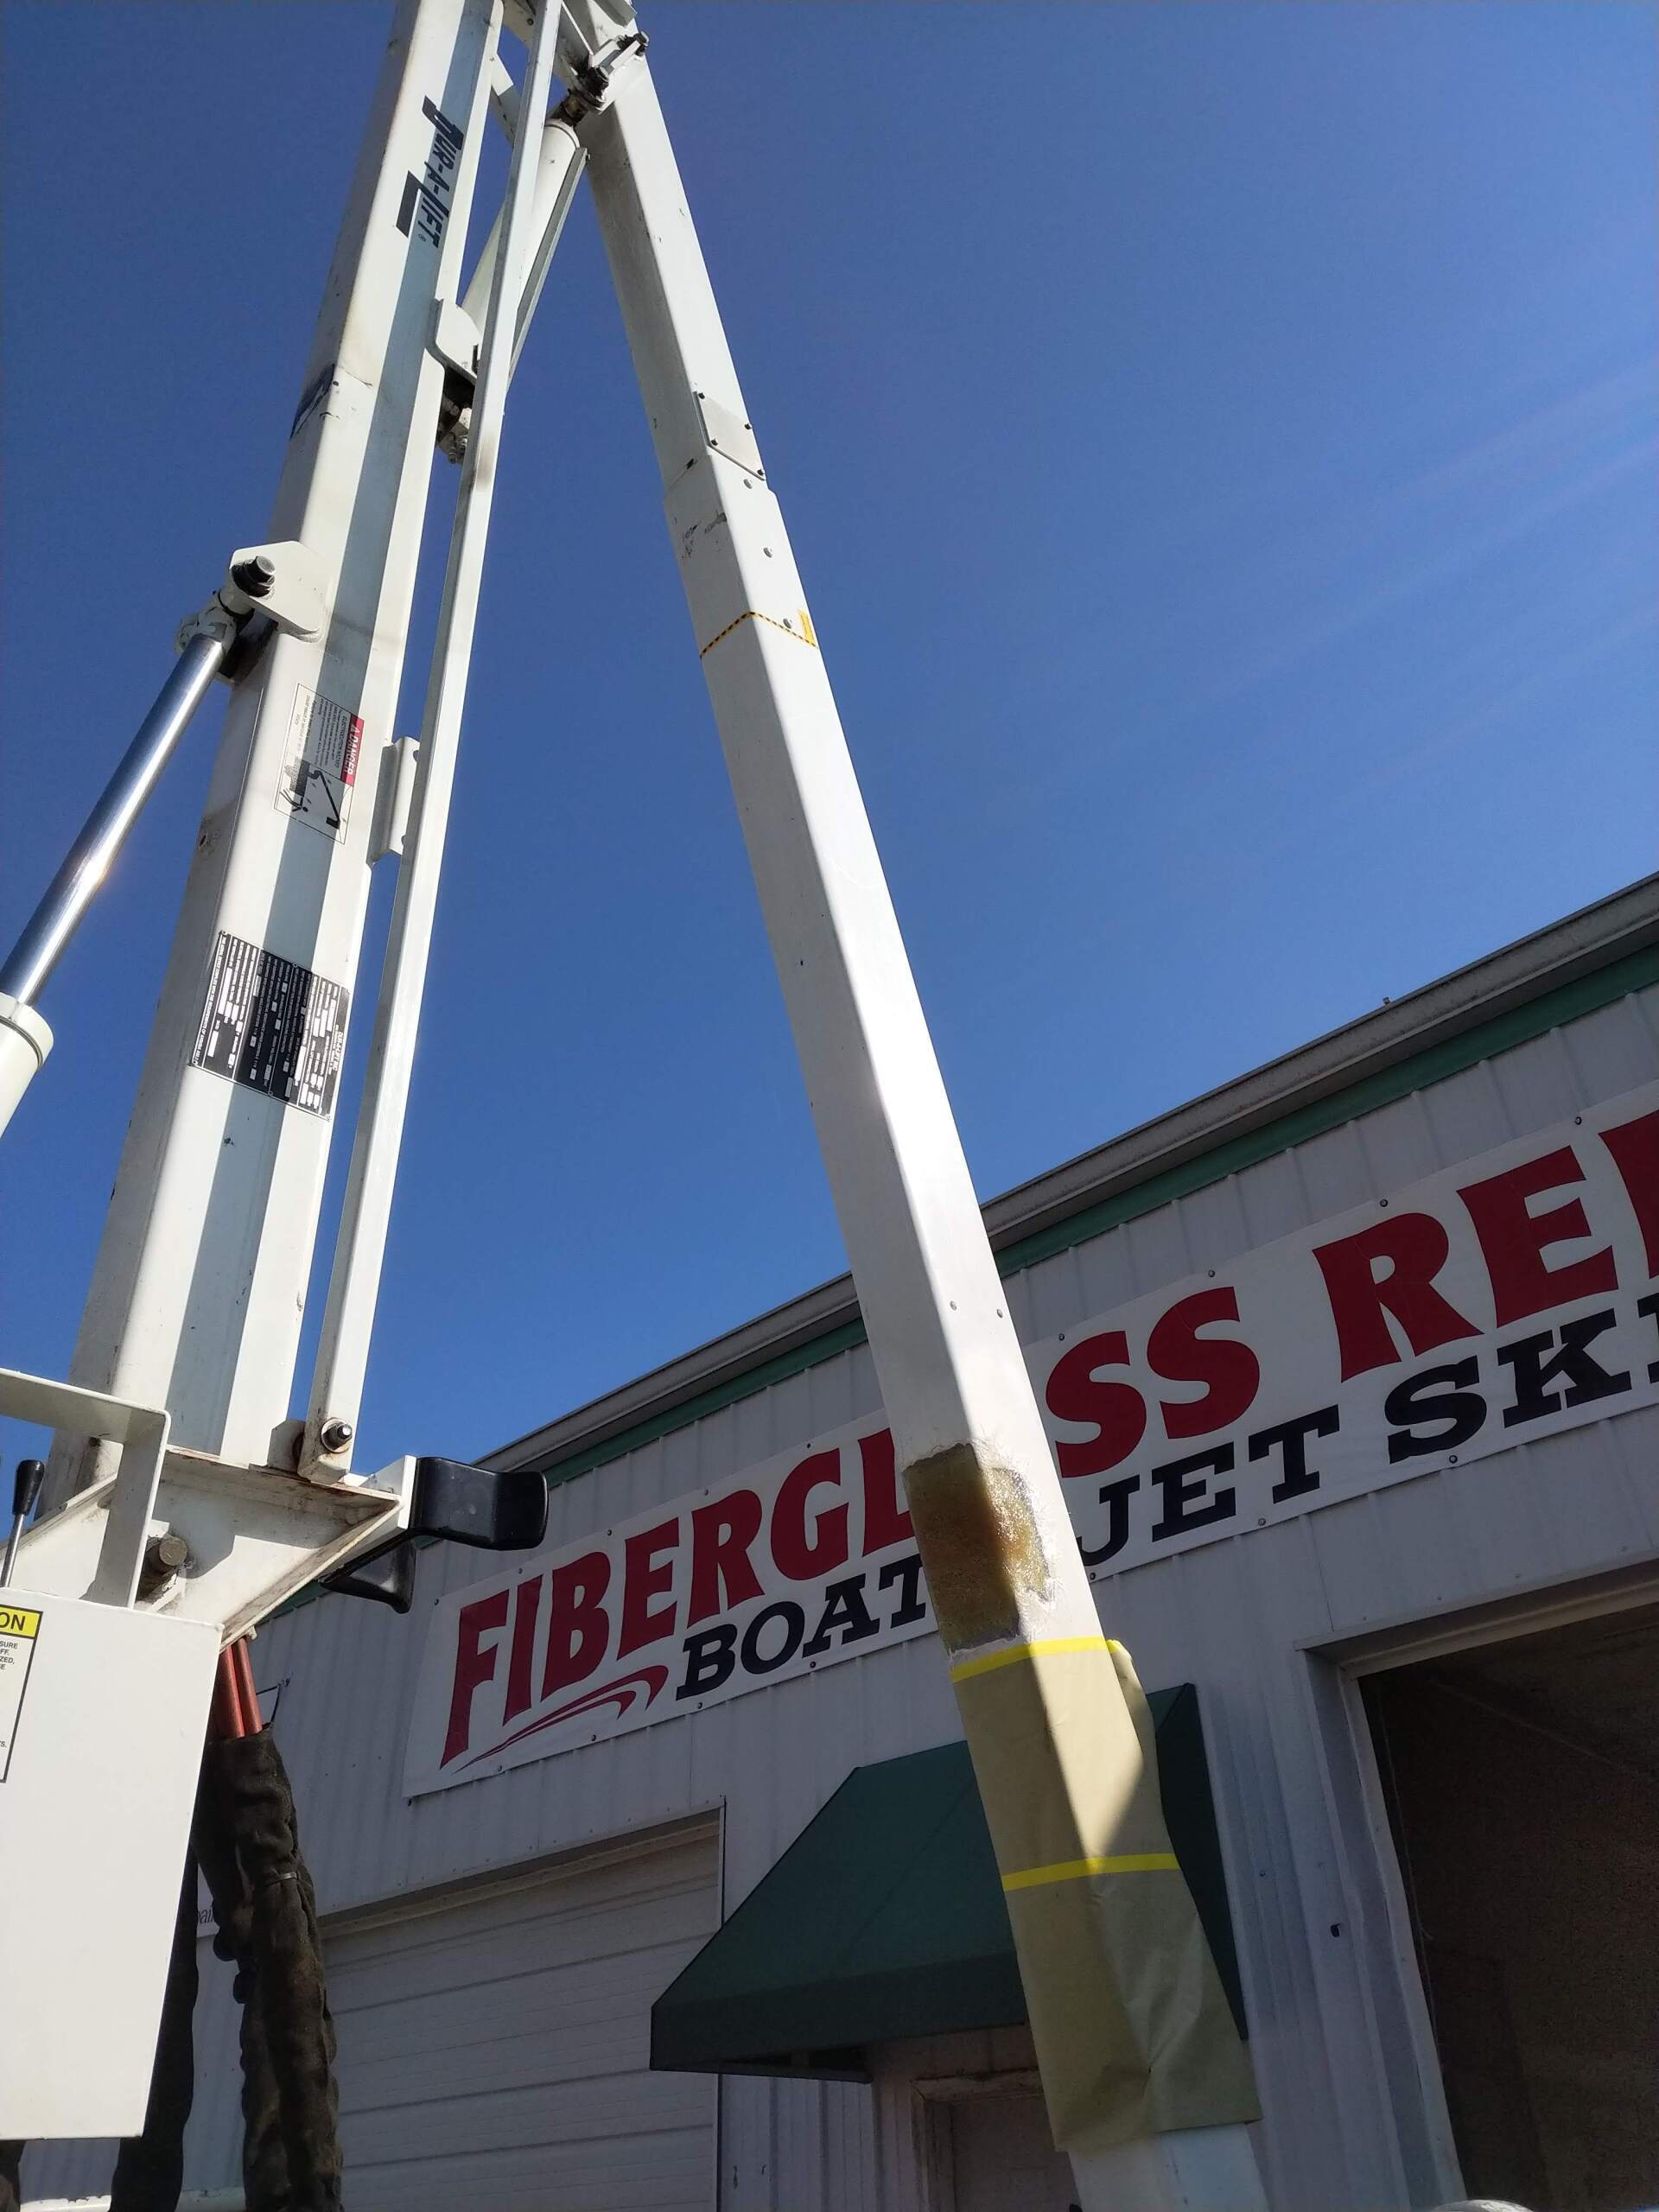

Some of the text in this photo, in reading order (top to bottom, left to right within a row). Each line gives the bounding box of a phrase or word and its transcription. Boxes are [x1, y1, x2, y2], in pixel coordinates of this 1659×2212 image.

[342, 733, 359, 776] DANGER
[439, 1286, 1260, 1769] FIBERGLSS
[1077, 1405, 1339, 1567] JET
